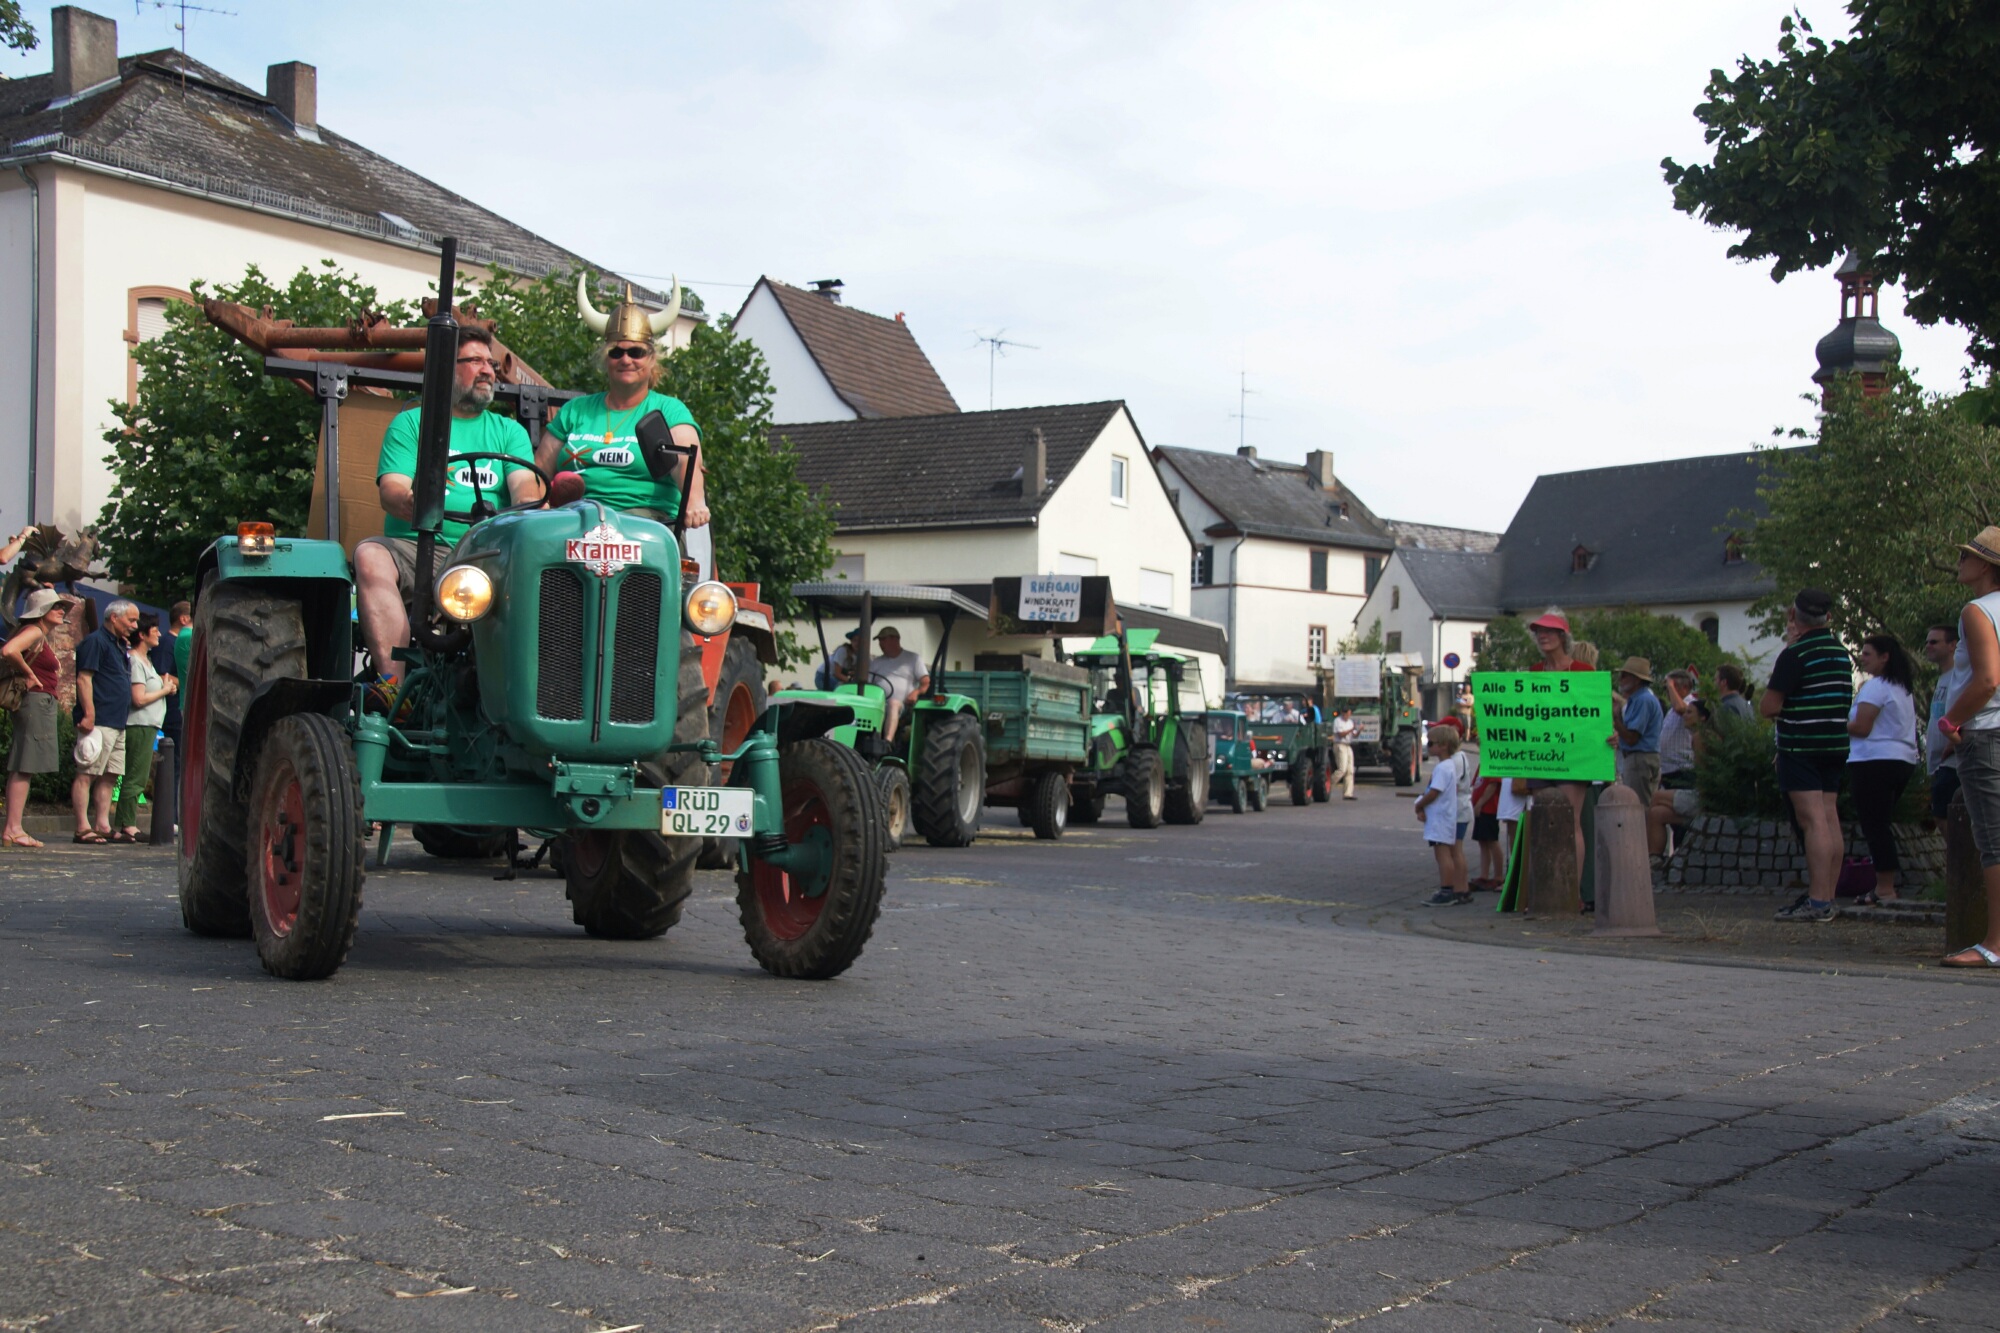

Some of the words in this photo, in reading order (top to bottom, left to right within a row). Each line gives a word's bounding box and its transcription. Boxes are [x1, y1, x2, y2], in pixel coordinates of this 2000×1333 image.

[567, 540, 641, 561] Kramer
[1482, 683, 1506, 693] Alle
[1514, 680, 1524, 693] 5
[1531, 683, 1552, 693] km
[1560, 680, 1569, 693] 5
[1483, 704, 1600, 721] Windgiganten
[1486, 728, 1527, 742] NEIN
[1488, 748, 1527, 760] Wehrt
[678, 791, 720, 811] RÜD
[672, 813, 700, 833] QL
[705, 814, 730, 834] 29
